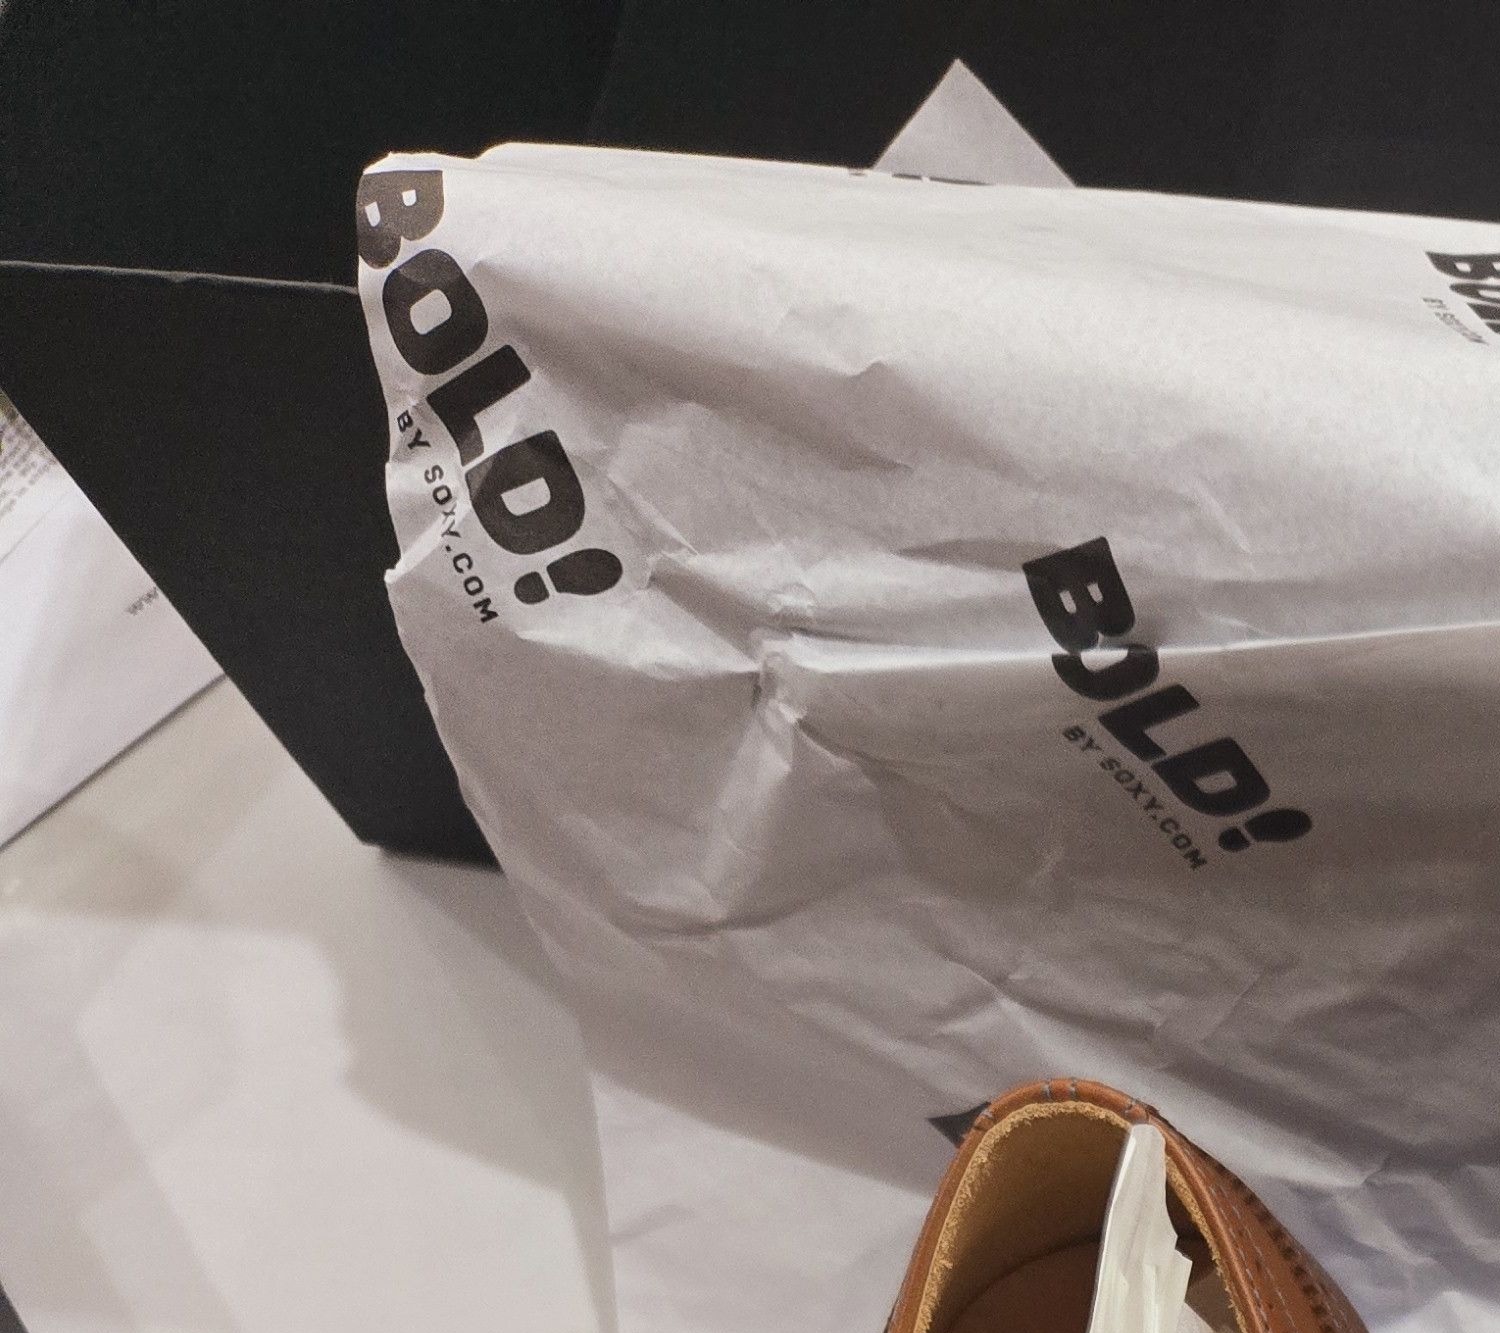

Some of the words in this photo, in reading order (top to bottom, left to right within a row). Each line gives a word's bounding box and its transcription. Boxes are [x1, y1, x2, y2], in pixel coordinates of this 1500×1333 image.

[356, 170, 623, 605] BOLD!
[396, 410, 430, 451] BY
[424, 464, 498, 624] SOXY.COM
[1063, 725, 1101, 752] BY
[1100, 756, 1207, 870] SOXY.COM
